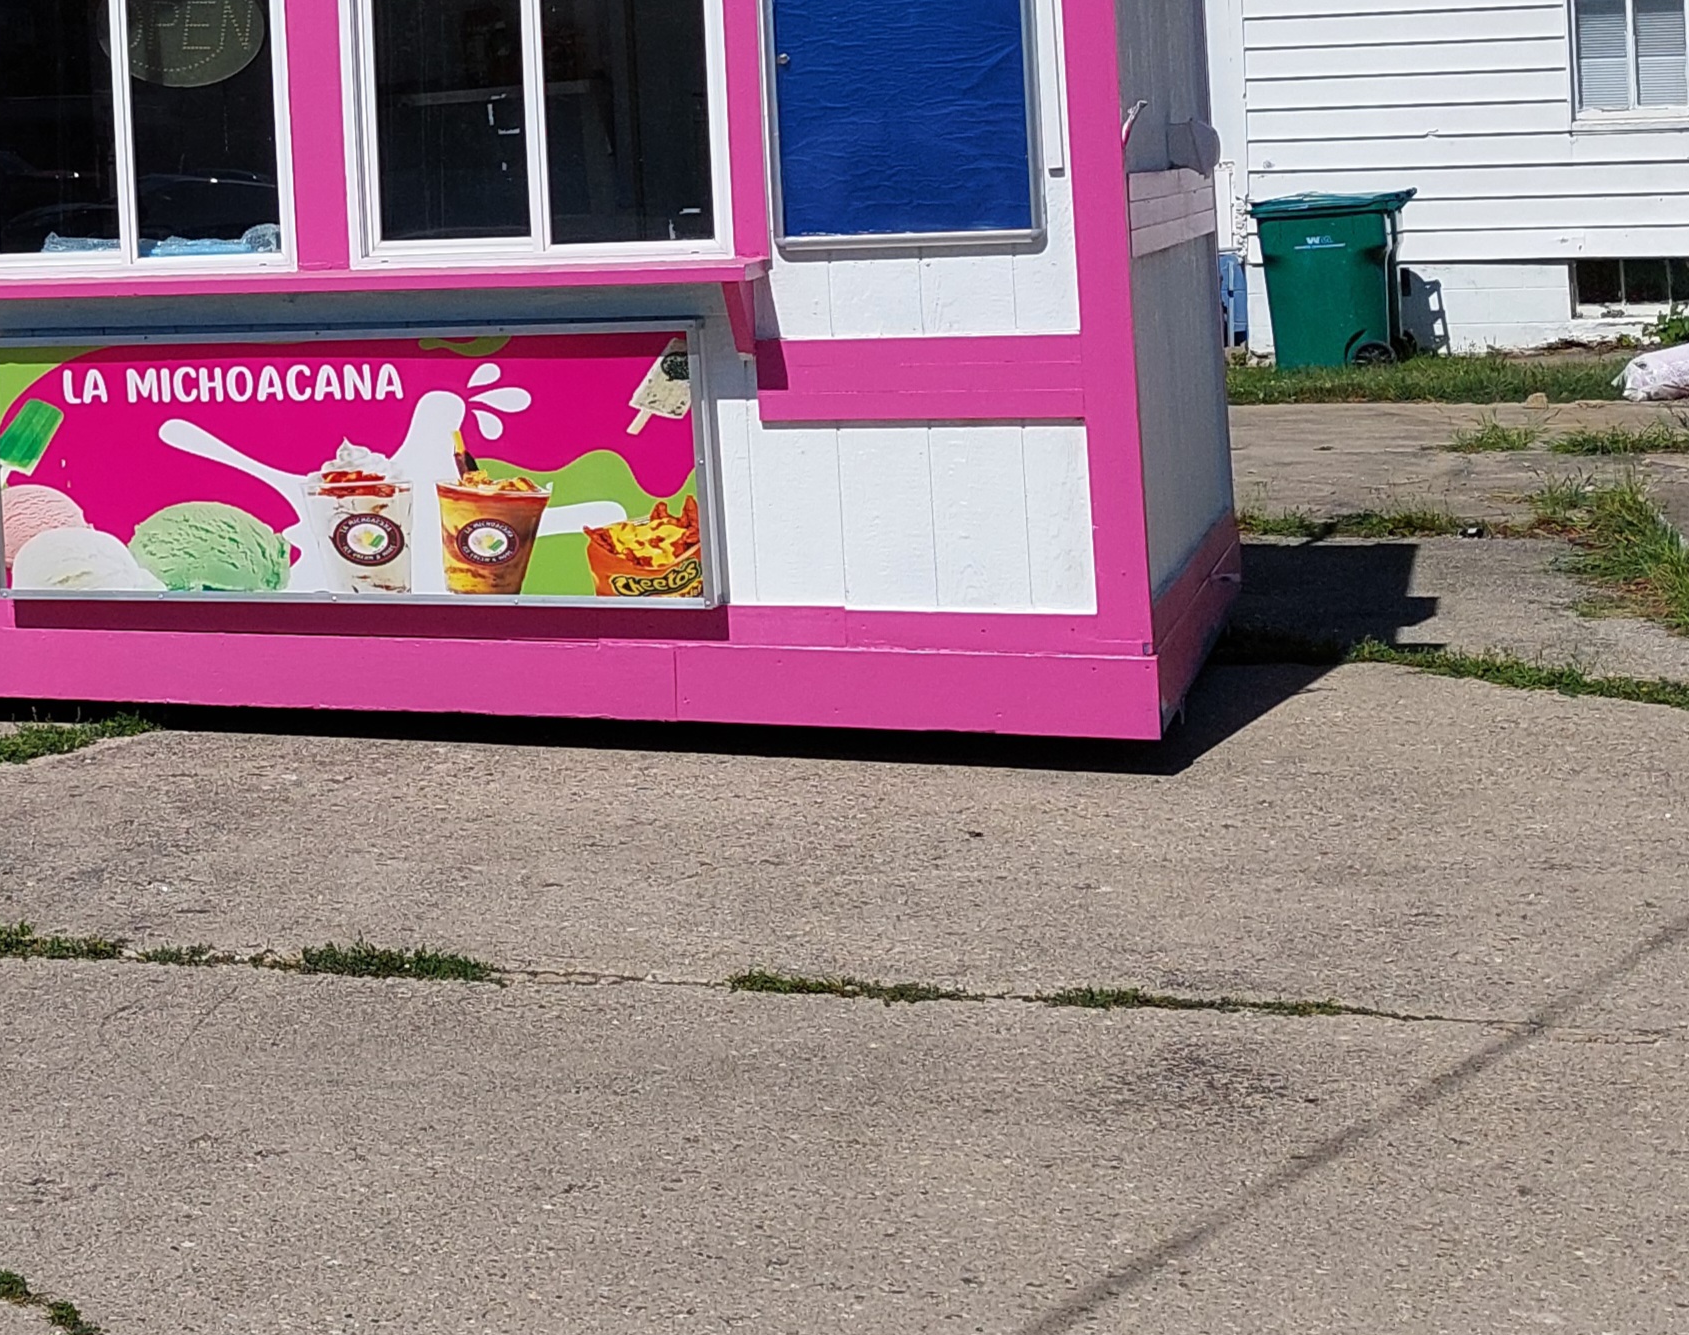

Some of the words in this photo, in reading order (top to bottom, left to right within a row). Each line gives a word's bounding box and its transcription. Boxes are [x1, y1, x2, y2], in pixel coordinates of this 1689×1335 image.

[62, 368, 109, 405] LA
[125, 363, 405, 405] MICHOACANA
[612, 561, 699, 595] Cheetos
